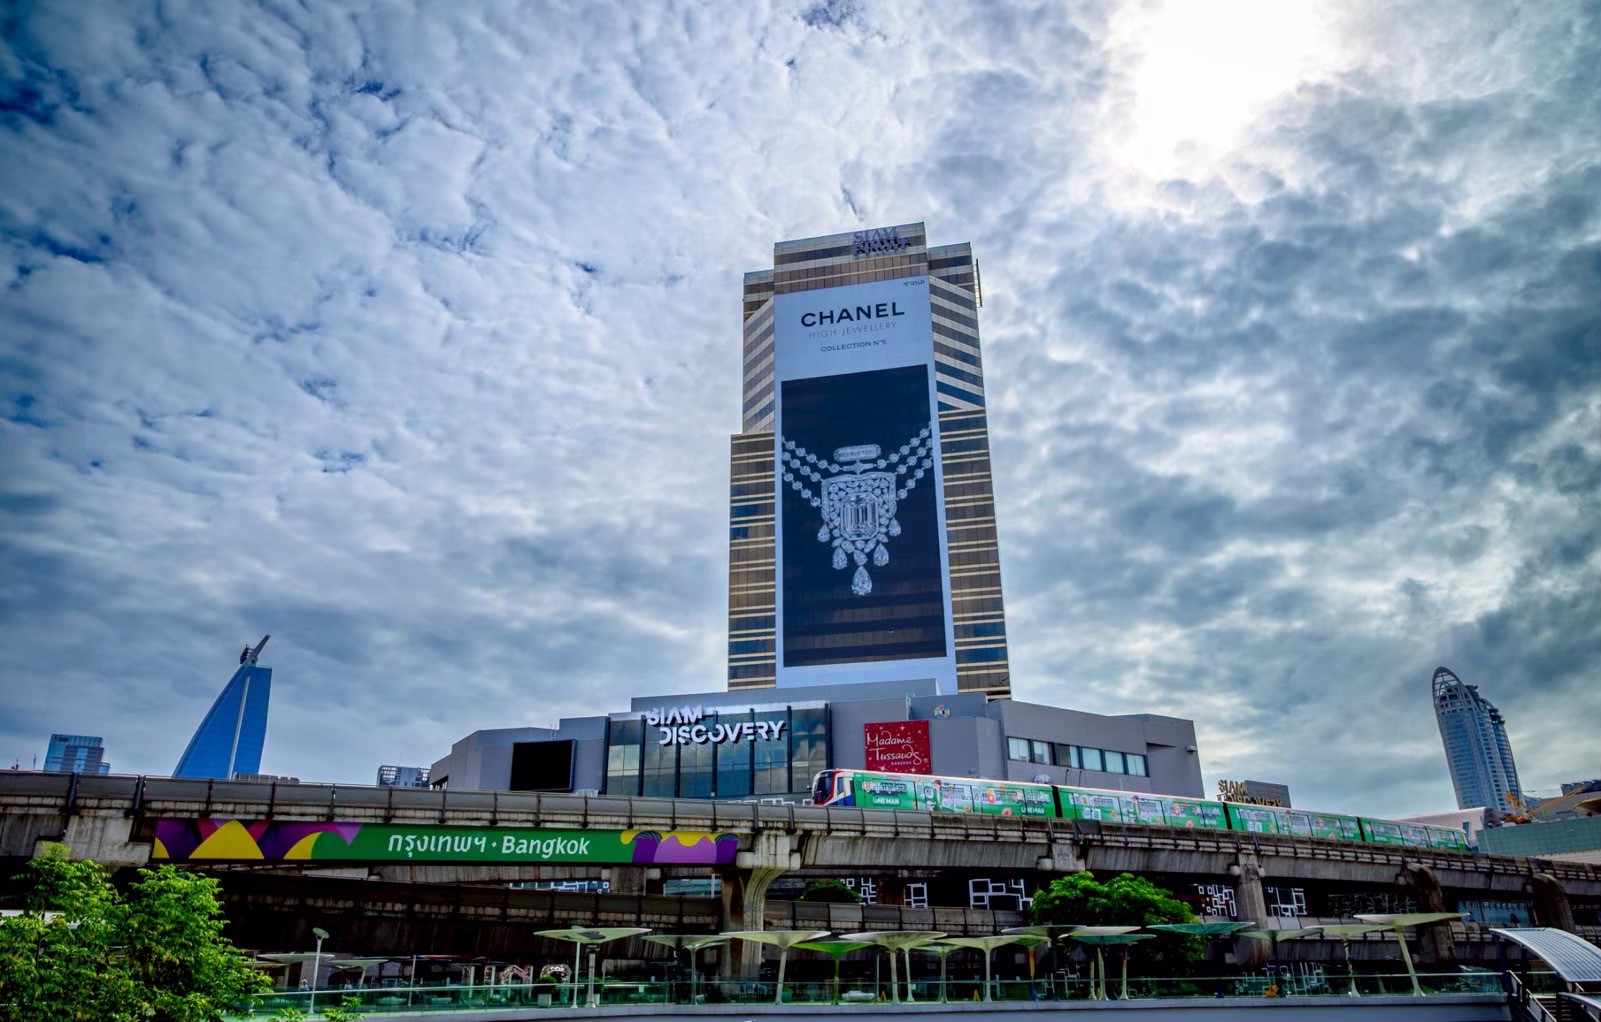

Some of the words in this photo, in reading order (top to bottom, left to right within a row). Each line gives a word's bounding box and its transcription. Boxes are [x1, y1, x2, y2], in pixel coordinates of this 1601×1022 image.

[854, 226, 898, 241] SIAM
[800, 301, 905, 328] CHANEL
[808, 328, 837, 339] HIGH
[841, 321, 897, 337] JEWELLERY
[820, 340, 872, 352] COLLECTION
[646, 704, 703, 726] SIAM
[659, 720, 785, 745] DISCOVERY
[866, 730, 915, 747] Madame
[868, 744, 923, 766] Tussauds
[1218, 779, 1248, 794] SIAM
[388, 834, 487, 858] กรุงเทพฯ
[501, 835, 591, 859] Bangkok
